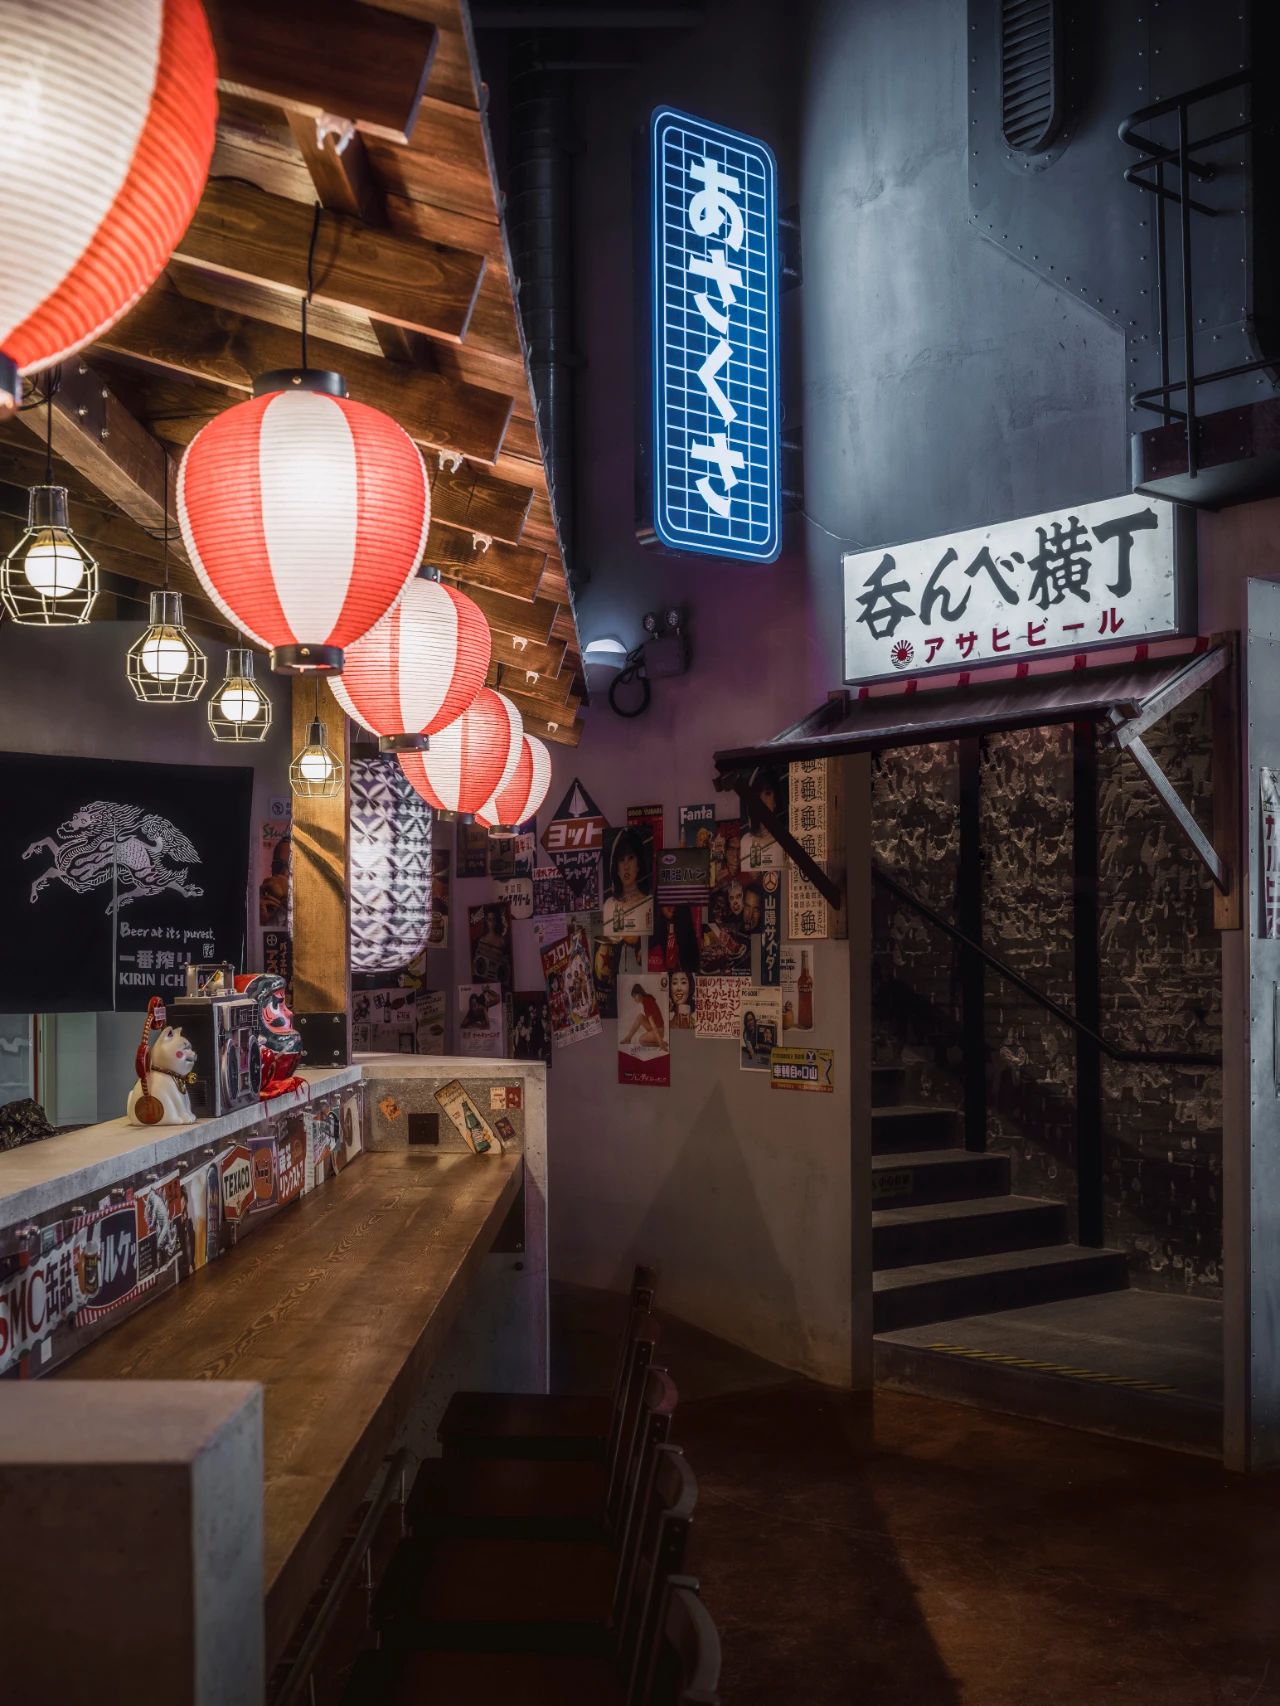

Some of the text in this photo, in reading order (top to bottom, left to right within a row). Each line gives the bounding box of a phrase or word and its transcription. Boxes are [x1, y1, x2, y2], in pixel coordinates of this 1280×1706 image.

[689, 157, 744, 518] あさくさ
[856, 507, 1159, 641] 呑んべ横丁
[924, 607, 1125, 664] アサヒビール
[680, 806, 713, 825] Fanta
[548, 822, 604, 848] ヨット
[120, 922, 216, 944] Beer at its purest.
[120, 972, 156, 987] KIRIN
[224, 1164, 250, 1201] TEXACO
